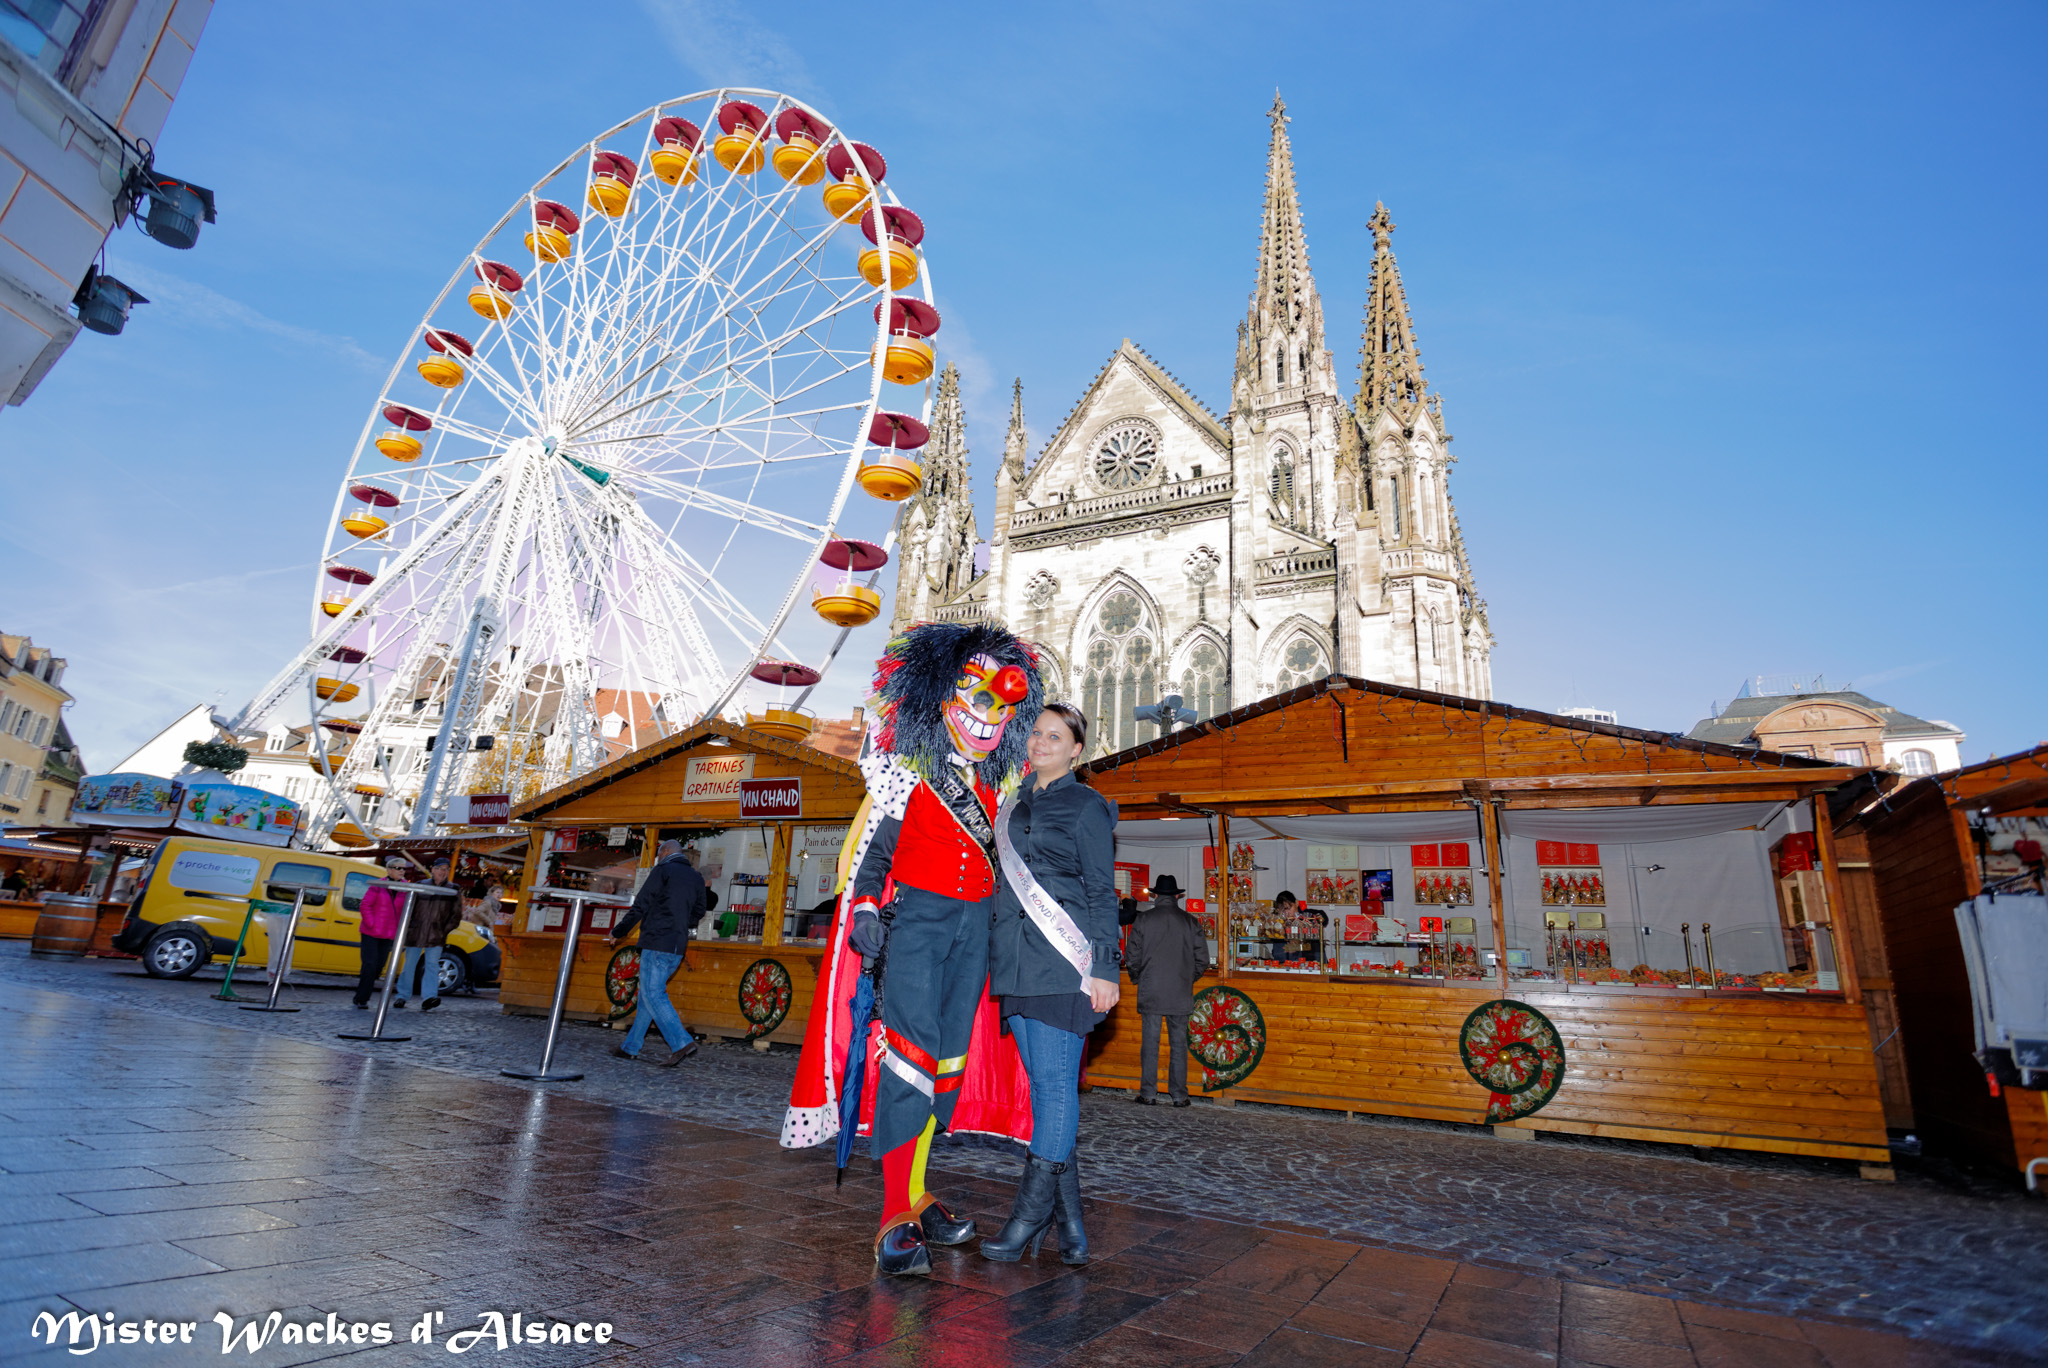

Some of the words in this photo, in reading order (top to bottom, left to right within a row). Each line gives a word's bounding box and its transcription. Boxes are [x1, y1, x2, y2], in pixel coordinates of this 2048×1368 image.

[695, 759, 746, 775] TARTINES
[686, 779, 740, 797] GRATINÉE
[741, 789, 759, 808] VIN
[760, 788, 799, 808] CHAUD
[470, 802, 483, 818] VIN
[482, 801, 509, 818] CHAUD
[961, 801, 993, 844] WACKES
[820, 836, 829, 847] de
[1016, 871, 1032, 892] MISS
[1030, 892, 1058, 925] RONDE
[1056, 927, 1085, 956] ALSACE
[1079, 949, 1093, 971] 2013
